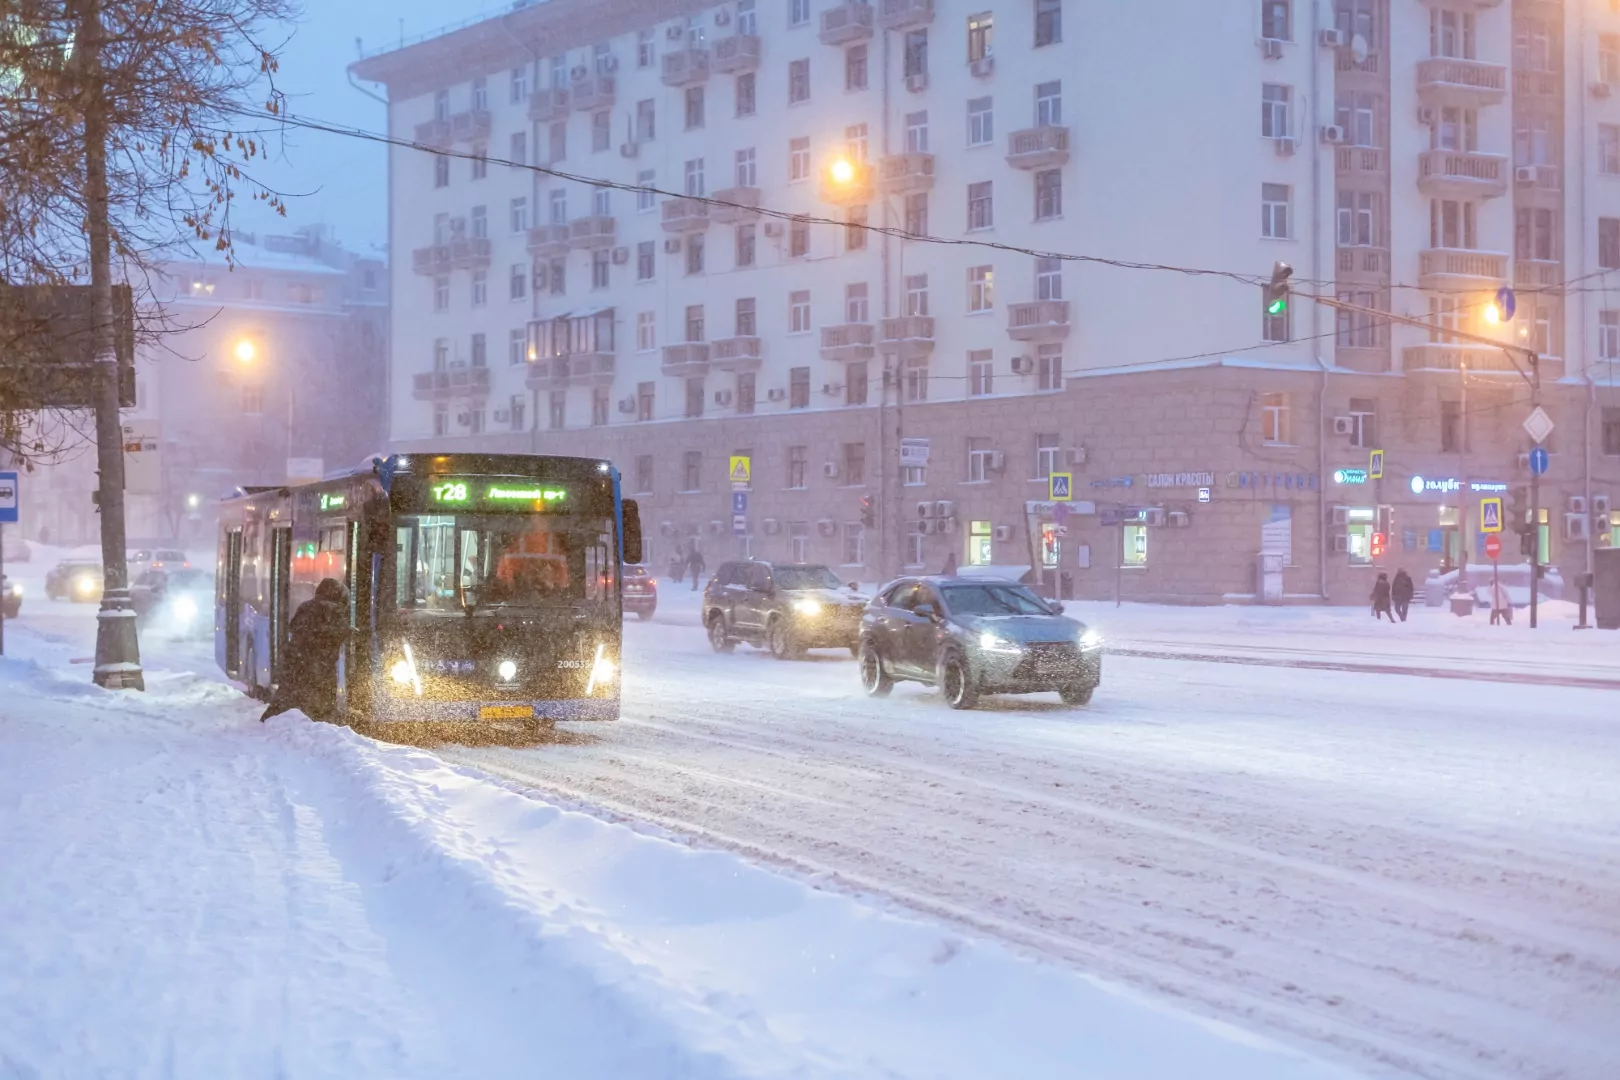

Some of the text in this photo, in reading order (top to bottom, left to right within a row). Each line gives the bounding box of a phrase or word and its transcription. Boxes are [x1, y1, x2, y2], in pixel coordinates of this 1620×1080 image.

[1147, 473, 1174, 488] САЛОН
[1175, 472, 1215, 487] КРАСОТЫ
[1425, 478, 1463, 493] голубк
